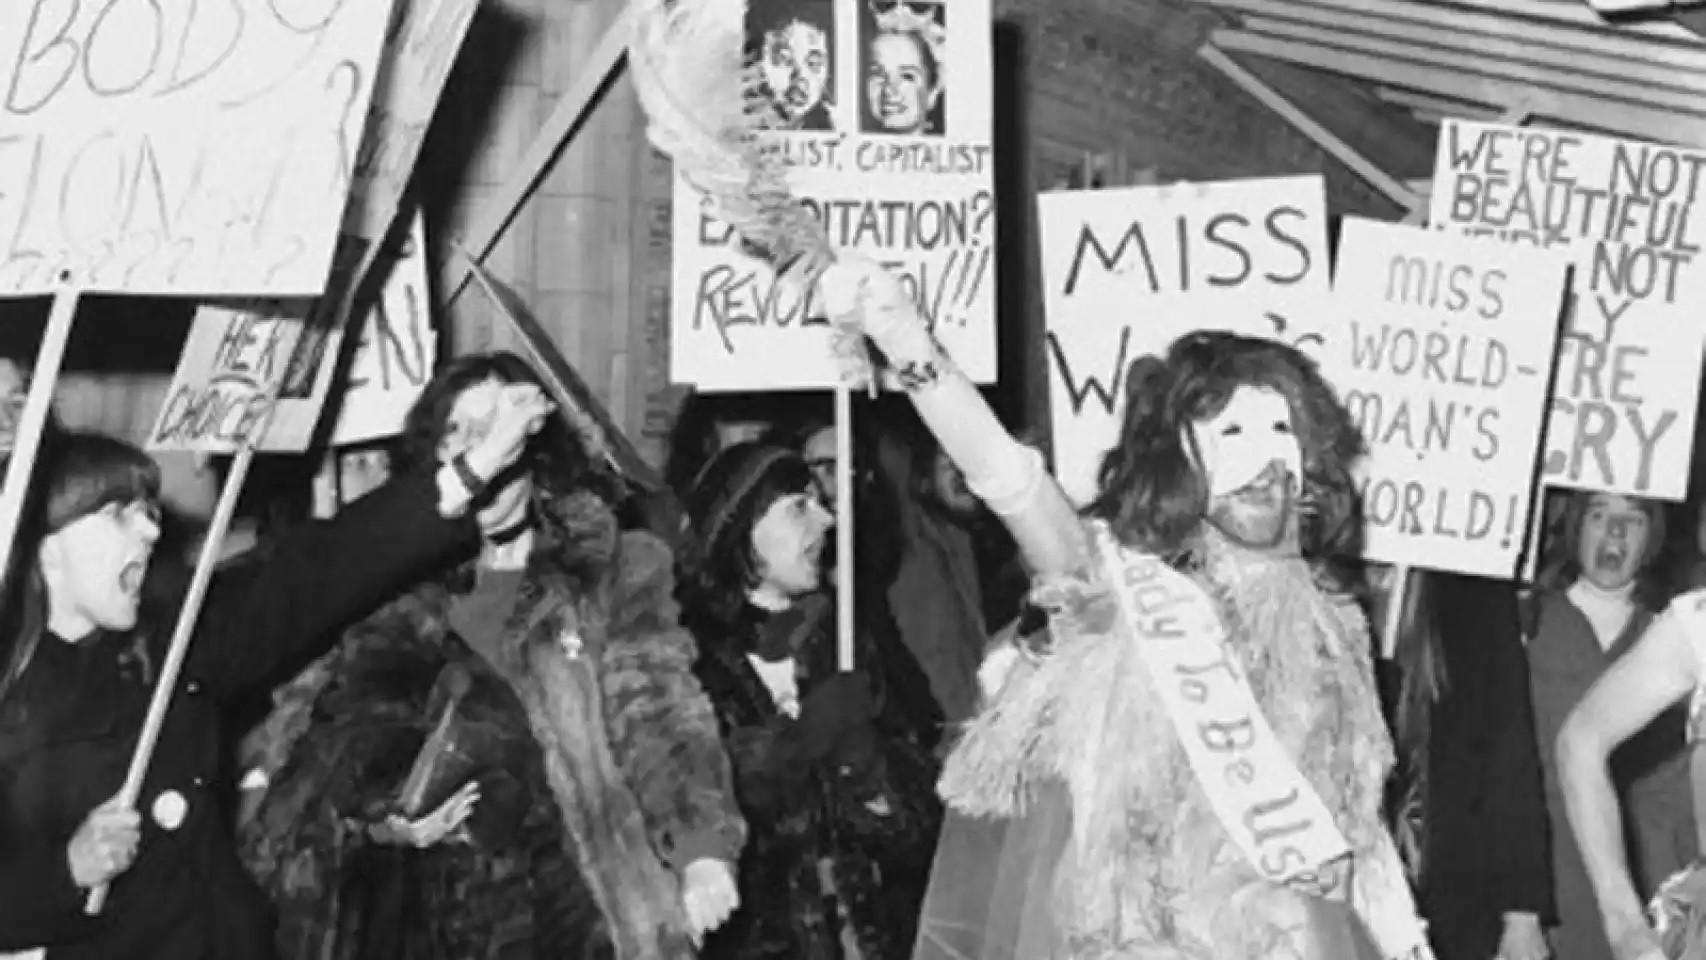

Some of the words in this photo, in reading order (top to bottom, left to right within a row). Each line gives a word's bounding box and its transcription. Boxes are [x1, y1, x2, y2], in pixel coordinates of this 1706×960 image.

[856, 141, 990, 173] CAPITALIST
[1450, 124, 1581, 182] WE'RE
[1608, 145, 1706, 203] NOT
[1451, 173, 1700, 252] BEAUTIFUL
[1063, 205, 1310, 295] MISS
[1590, 240, 1691, 303] NOT
[1385, 254, 1508, 319] MISS
[1562, 290, 1634, 343] LY
[1345, 388, 1501, 461] MAN'S
[1124, 564, 1196, 640] ady
[1174, 643, 1241, 704] To
[1198, 714, 1256, 786] Be
